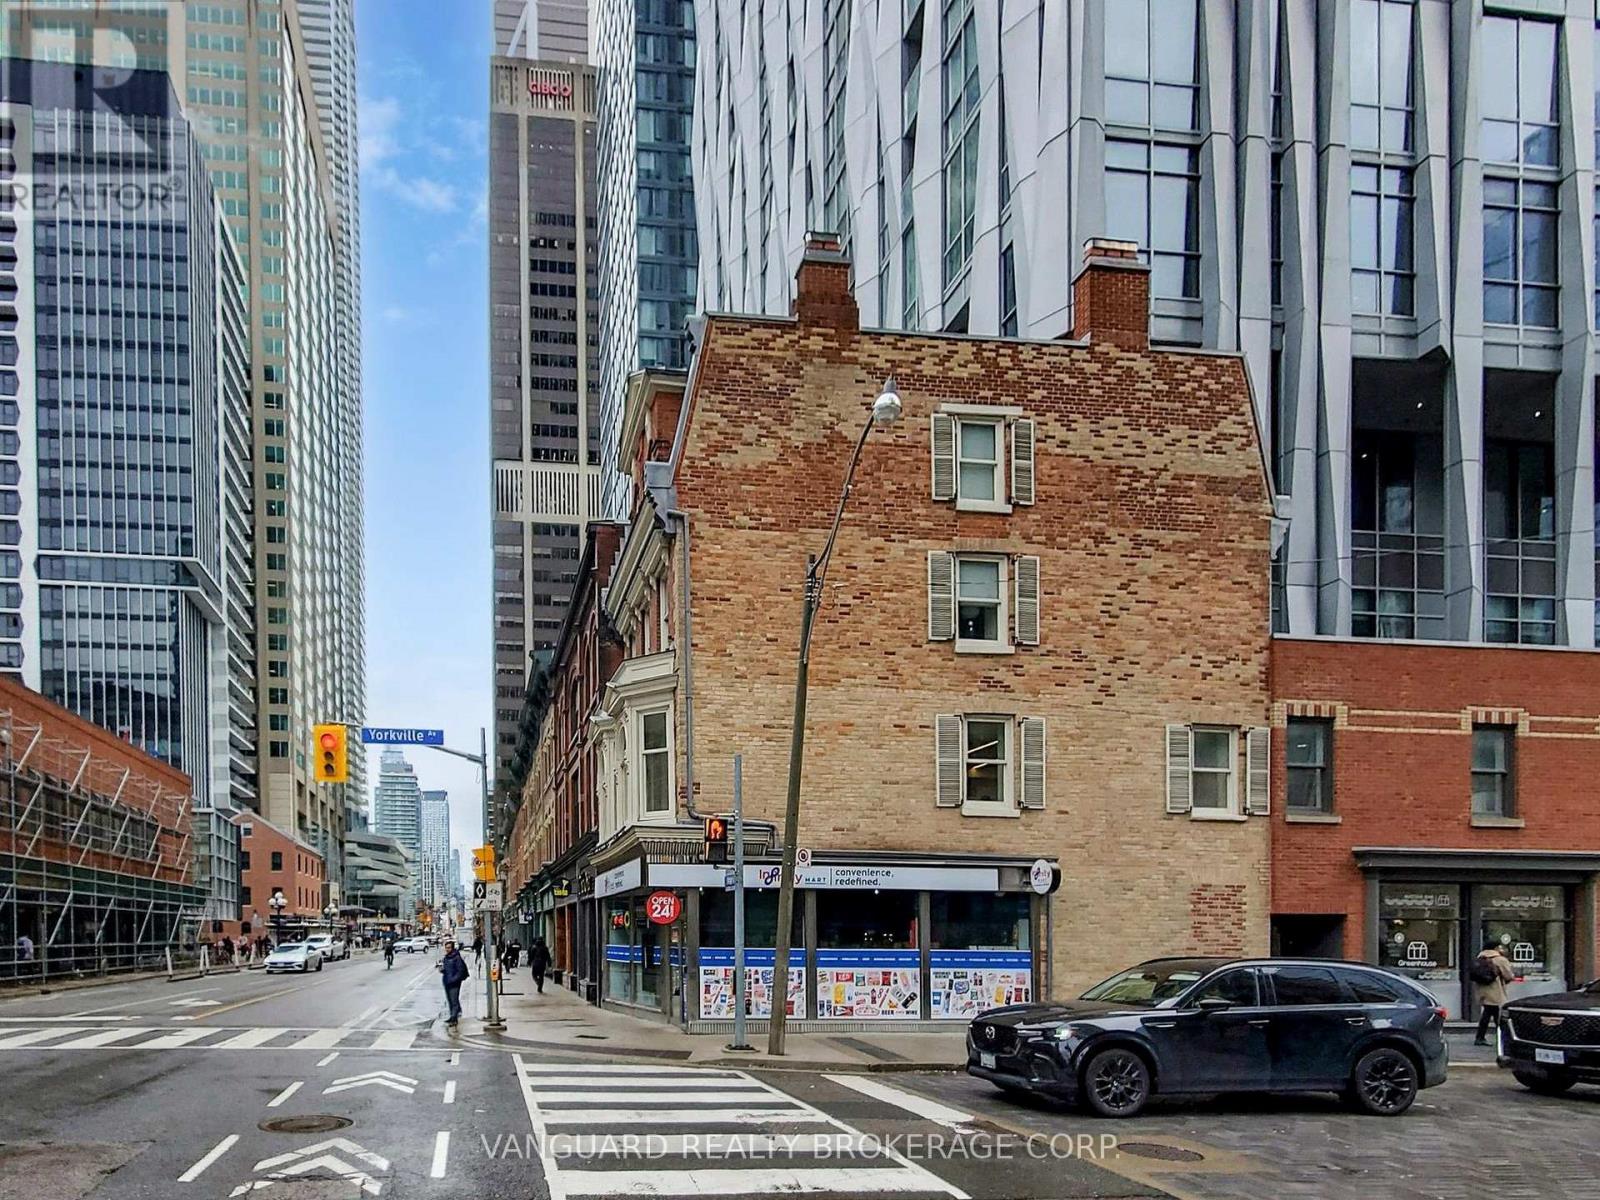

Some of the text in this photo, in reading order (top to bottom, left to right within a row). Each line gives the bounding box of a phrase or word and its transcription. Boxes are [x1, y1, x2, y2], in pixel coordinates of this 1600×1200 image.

[368, 728, 424, 742] Yorkville
[835, 877, 881, 886] redefined.
[651, 896, 675, 905] OPEN
[1397, 959, 1438, 967] Greenhouse
